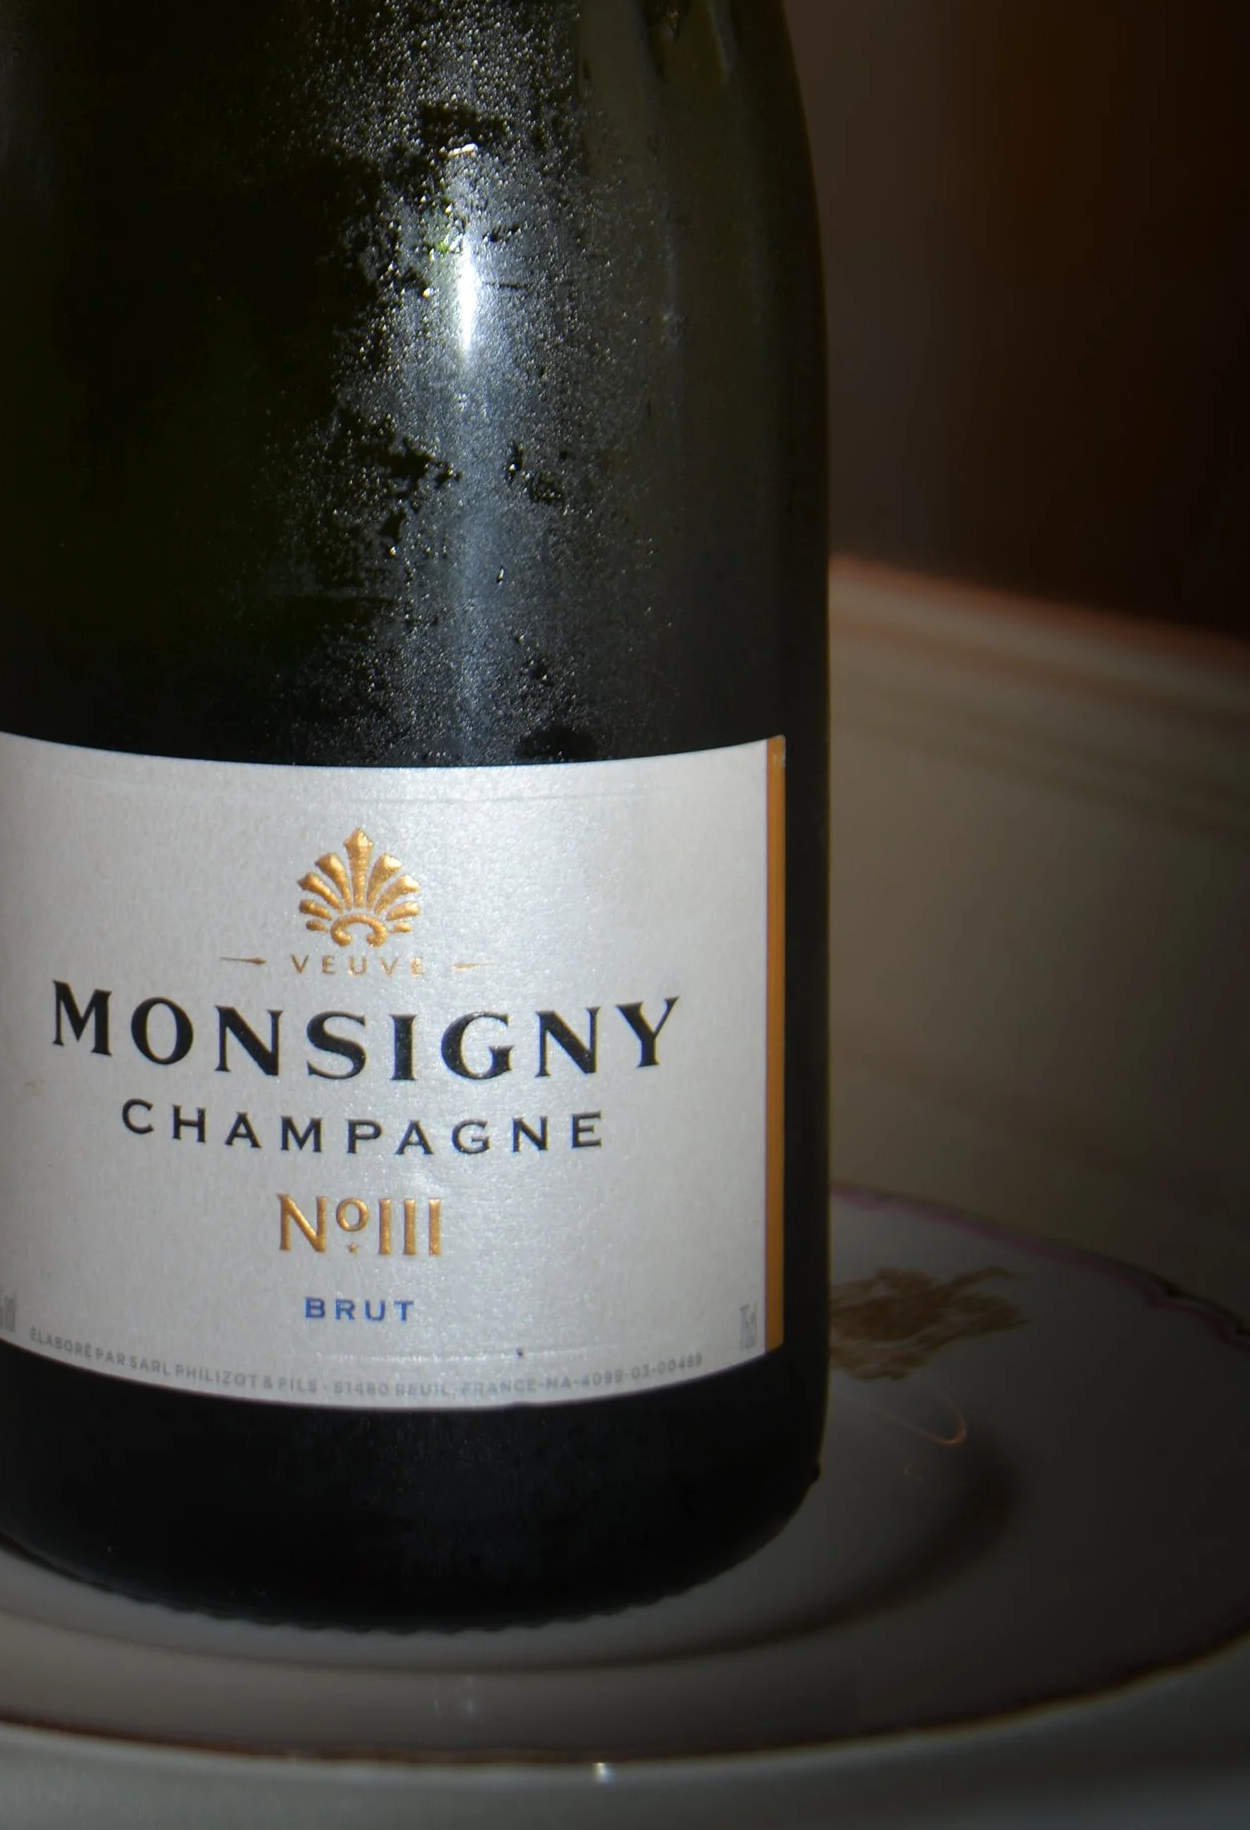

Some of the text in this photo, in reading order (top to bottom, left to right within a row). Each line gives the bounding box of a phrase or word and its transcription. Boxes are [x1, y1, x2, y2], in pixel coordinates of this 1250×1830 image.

[291, 953, 425, 978] VEUVE
[52, 980, 680, 1082] MONSIGNY
[122, 1098, 604, 1157] CHAMPAGNE
[304, 1297, 415, 1323] BRUT
[96, 1347, 126, 1367] PAR
[130, 1354, 172, 1377] SARL
[175, 1363, 259, 1389] PHILIZOT
